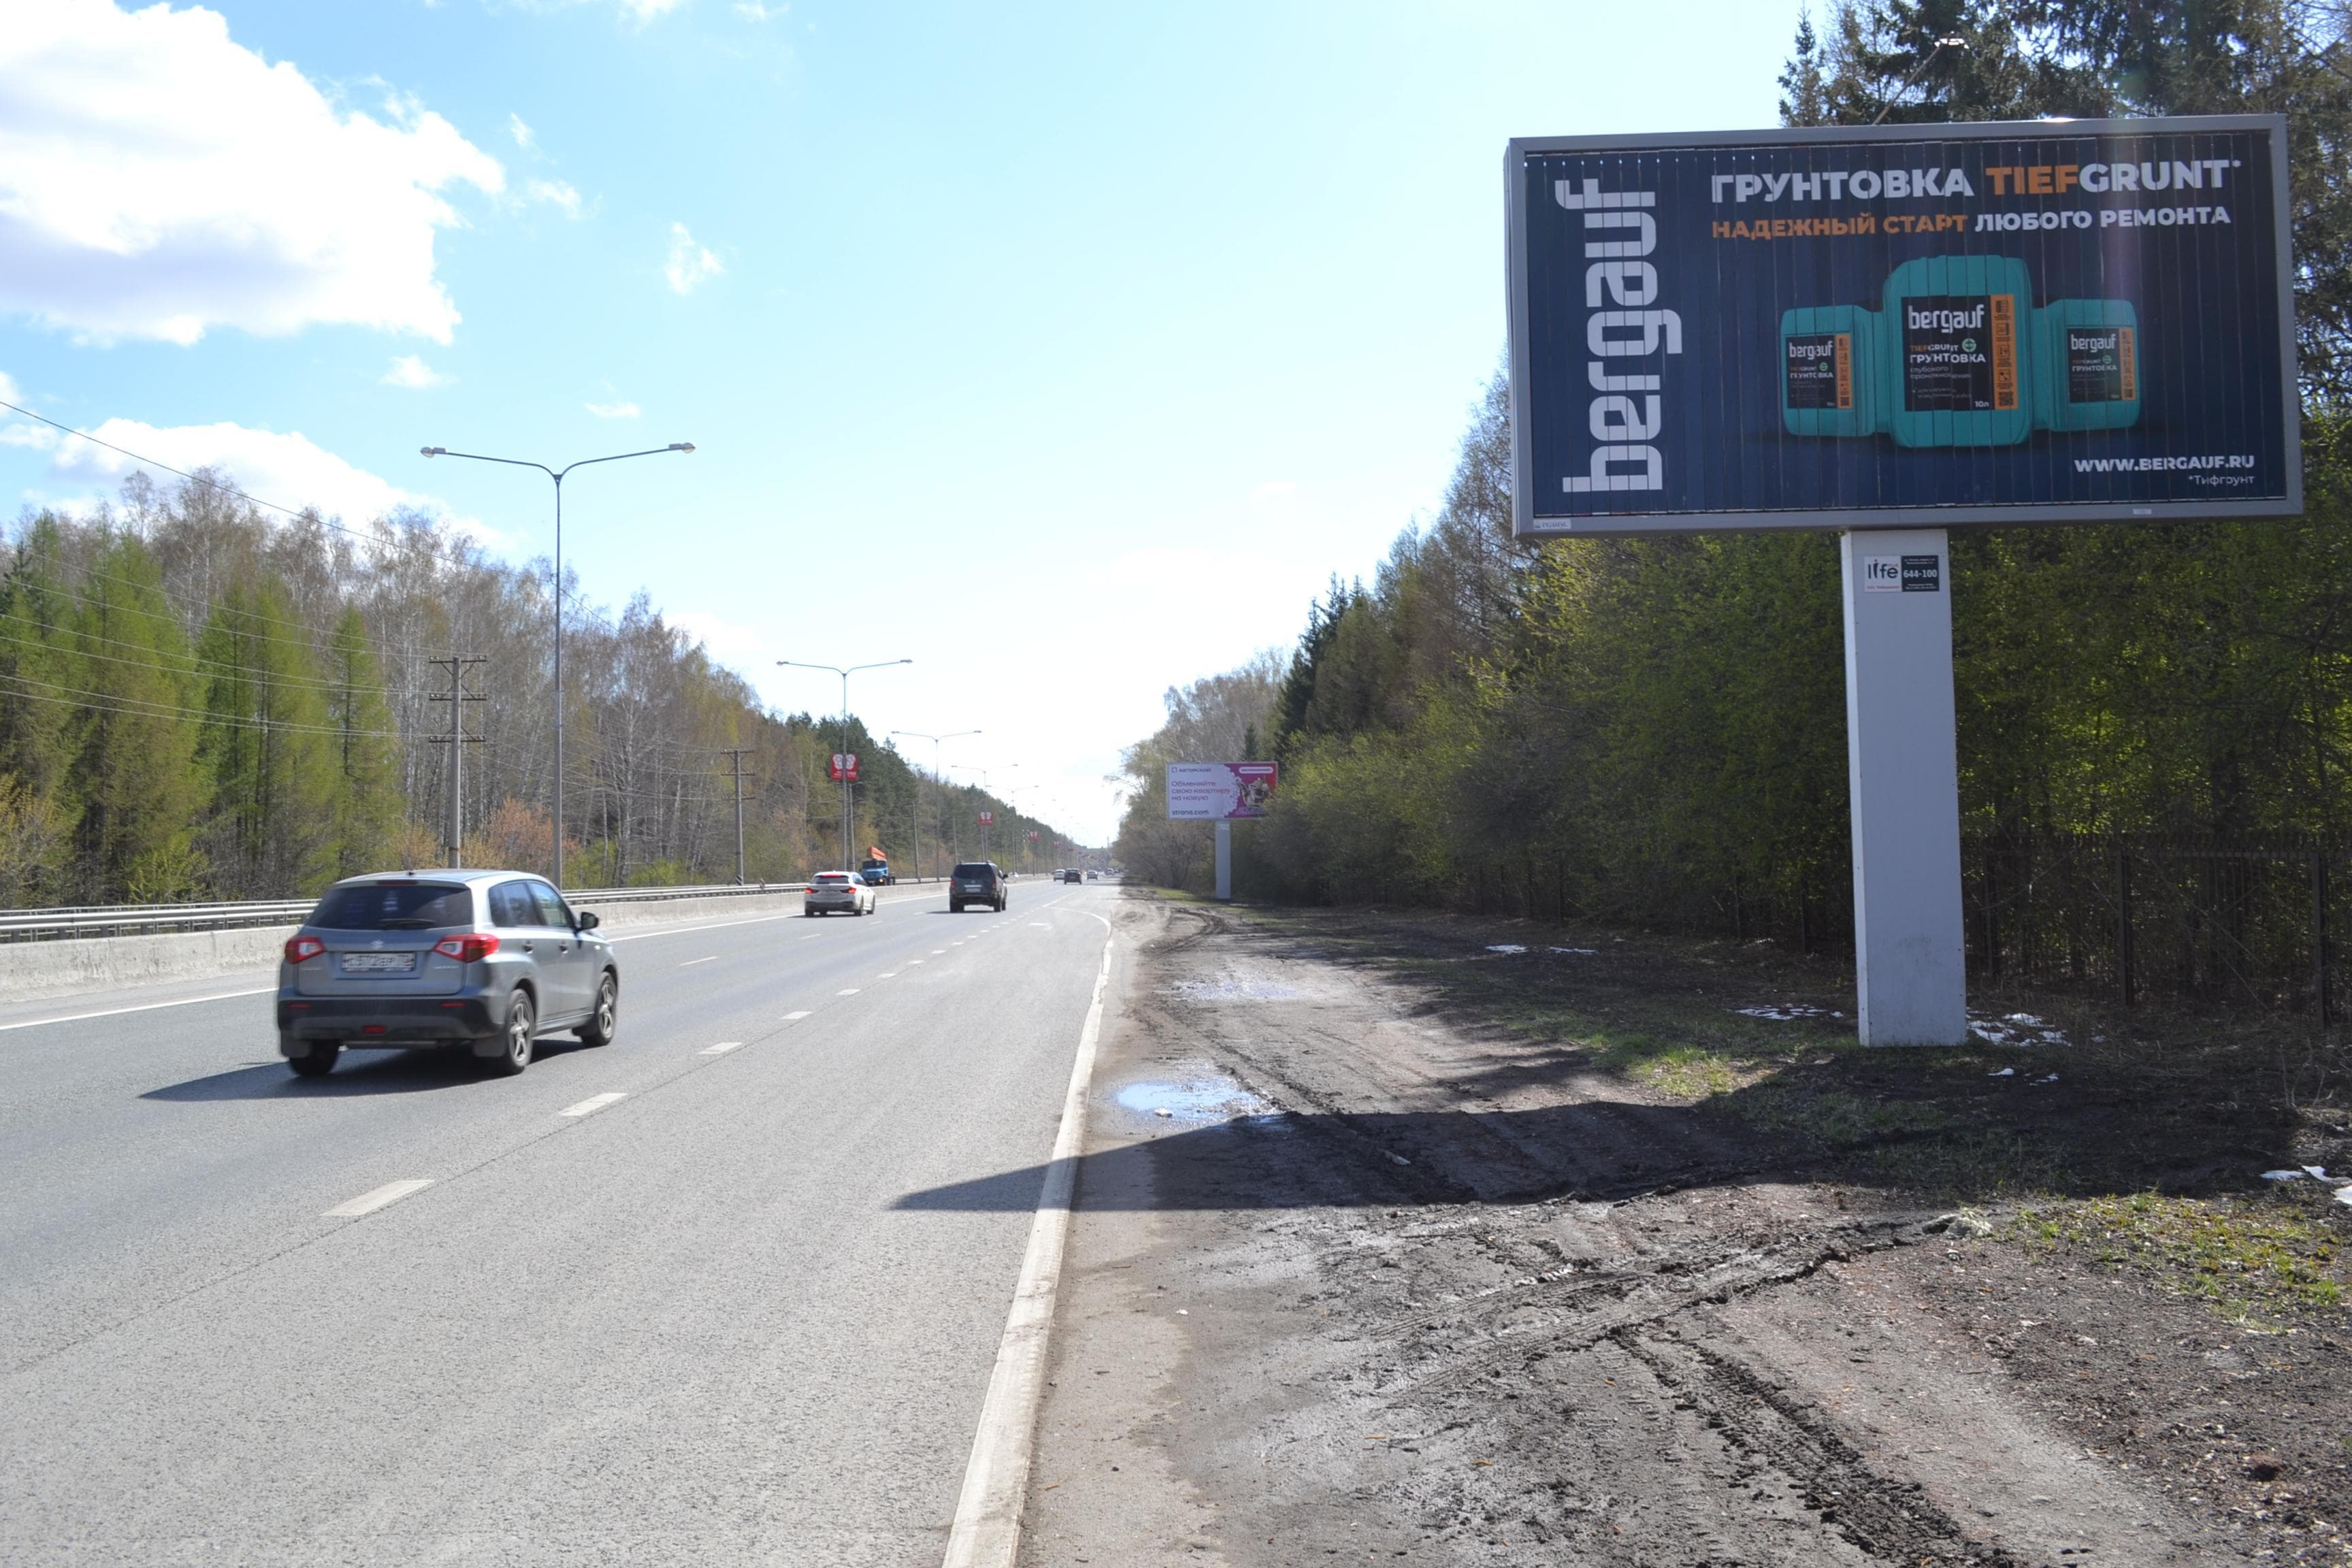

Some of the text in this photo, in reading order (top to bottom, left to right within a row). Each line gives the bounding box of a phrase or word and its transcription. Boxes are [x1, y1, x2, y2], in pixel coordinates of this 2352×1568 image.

[1712, 167, 1974, 203] ГРУНТОВКА
[1712, 206, 2232, 240] НАДЕЖНЫЙ СТАРТ ЛЮБОГО РЕМОНТА
[1908, 304, 1985, 333] bergauf
[1554, 178, 1682, 492] bergauf
[2071, 333, 2117, 353] bergauf
[1789, 340, 1833, 360] bergauf
[1910, 353, 1987, 363] ГРУНТОВКА
[2074, 455, 2255, 472] WWW.BERGAUF.RU
[1903, 569, 1938, 578] 644-100
